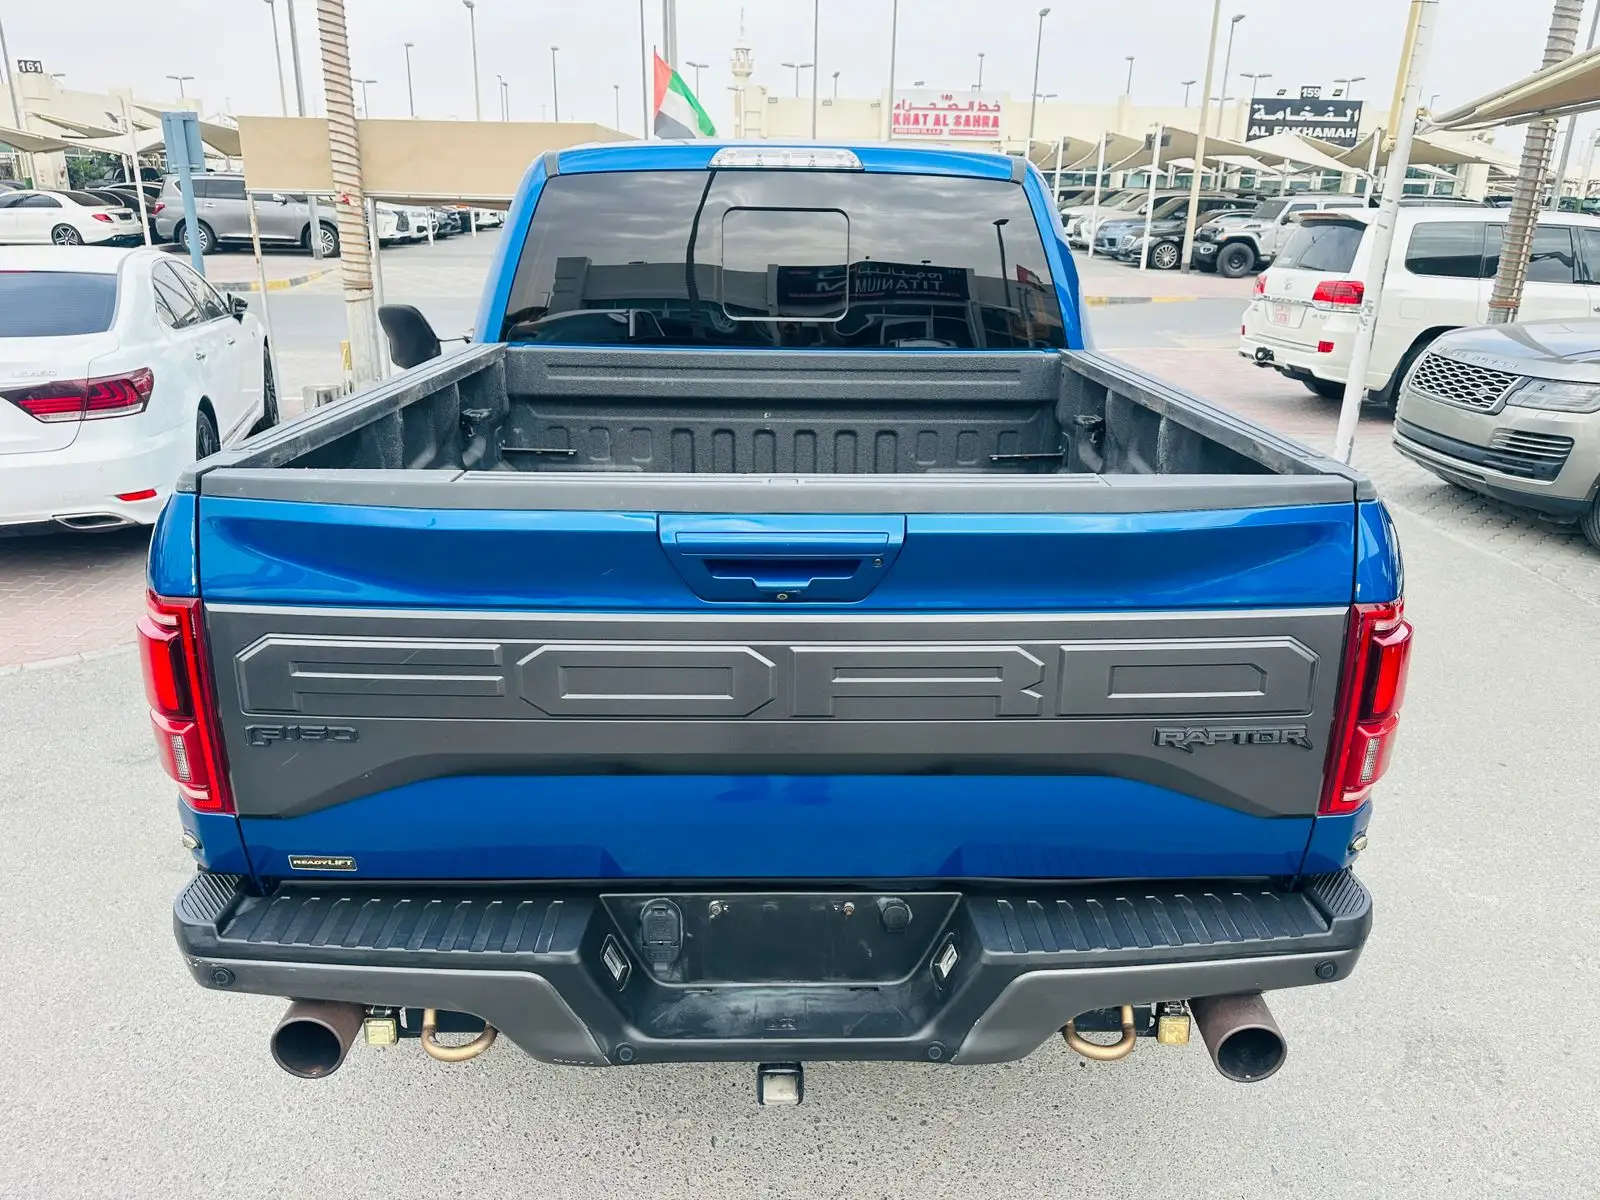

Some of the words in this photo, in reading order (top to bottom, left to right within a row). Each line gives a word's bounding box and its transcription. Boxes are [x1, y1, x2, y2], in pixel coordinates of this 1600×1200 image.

[20, 61, 42, 72] 161
[1301, 87, 1320, 98] 159
[893, 113, 929, 126] KHAT
[933, 114, 949, 127] AL
[953, 115, 1000, 128] SAHRA
[1252, 104, 1359, 123] الفخامة
[1249, 126, 1270, 137] AL
[238, 637, 1317, 718] FORD
[1153, 723, 1313, 753] RAPTOR
